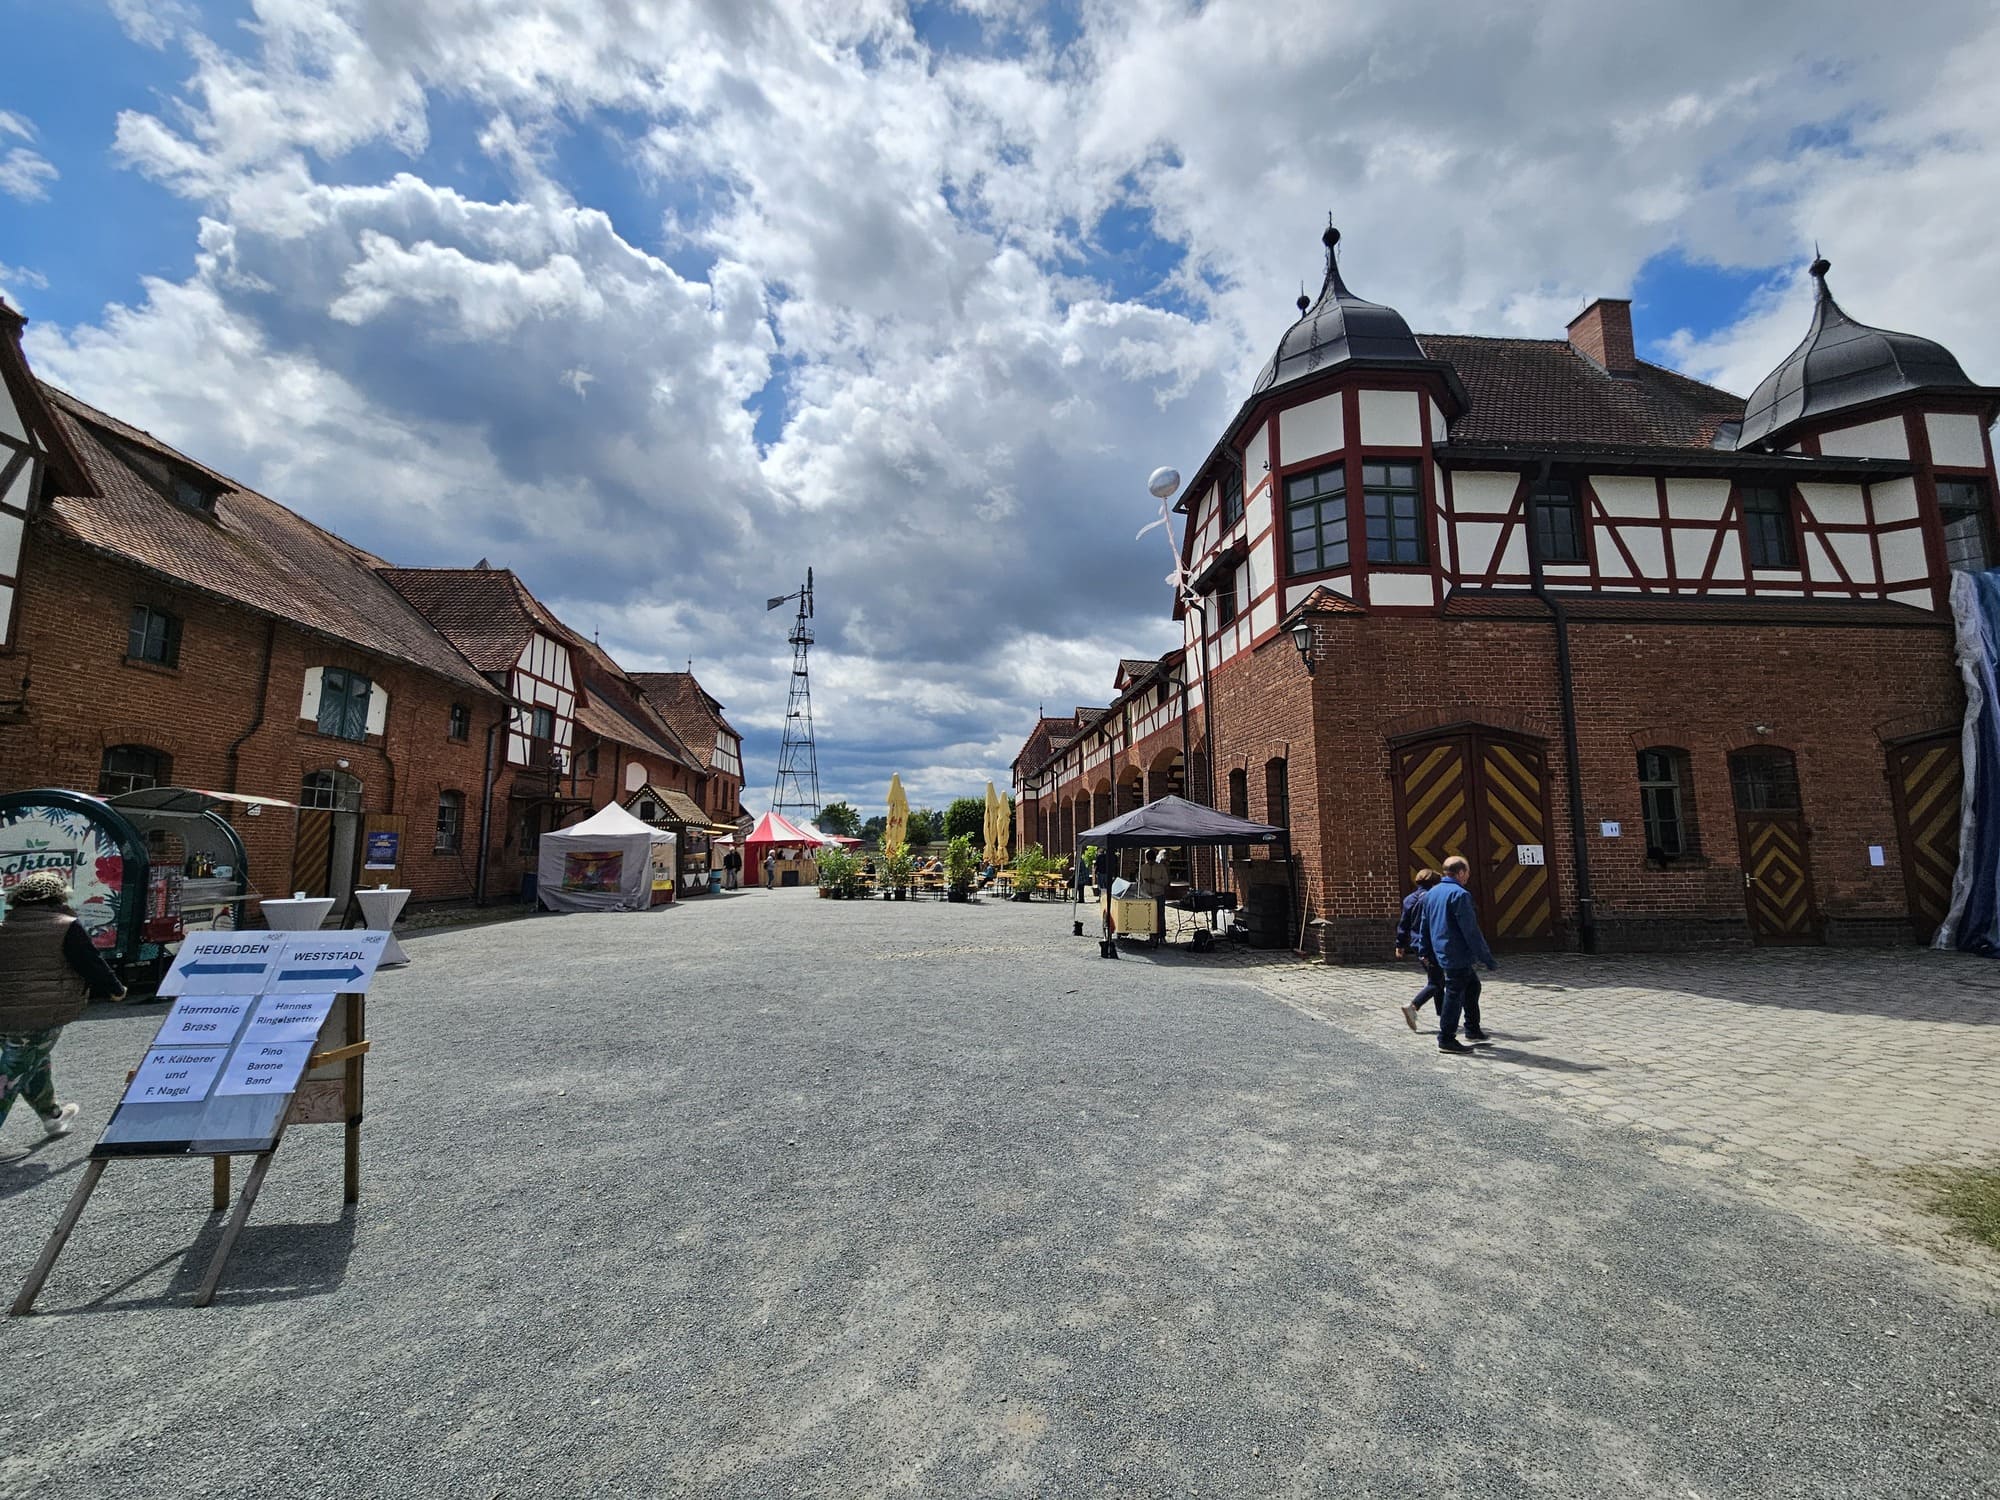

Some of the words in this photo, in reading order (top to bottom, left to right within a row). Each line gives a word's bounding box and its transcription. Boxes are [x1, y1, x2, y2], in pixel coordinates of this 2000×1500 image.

[194, 944, 270, 955] HEUBODEN
[293, 951, 365, 961] WESTSTADL
[178, 1005, 240, 1015] Harmonic
[182, 1023, 217, 1032] Brass
[260, 1047, 283, 1056] Pino
[153, 1056, 166, 1064] M.
[247, 1062, 283, 1071] Barone
[165, 1070, 188, 1079] und
[245, 1076, 273, 1085] Band
[145, 1087, 155, 1095] F.
[157, 1086, 191, 1096] Nagel
